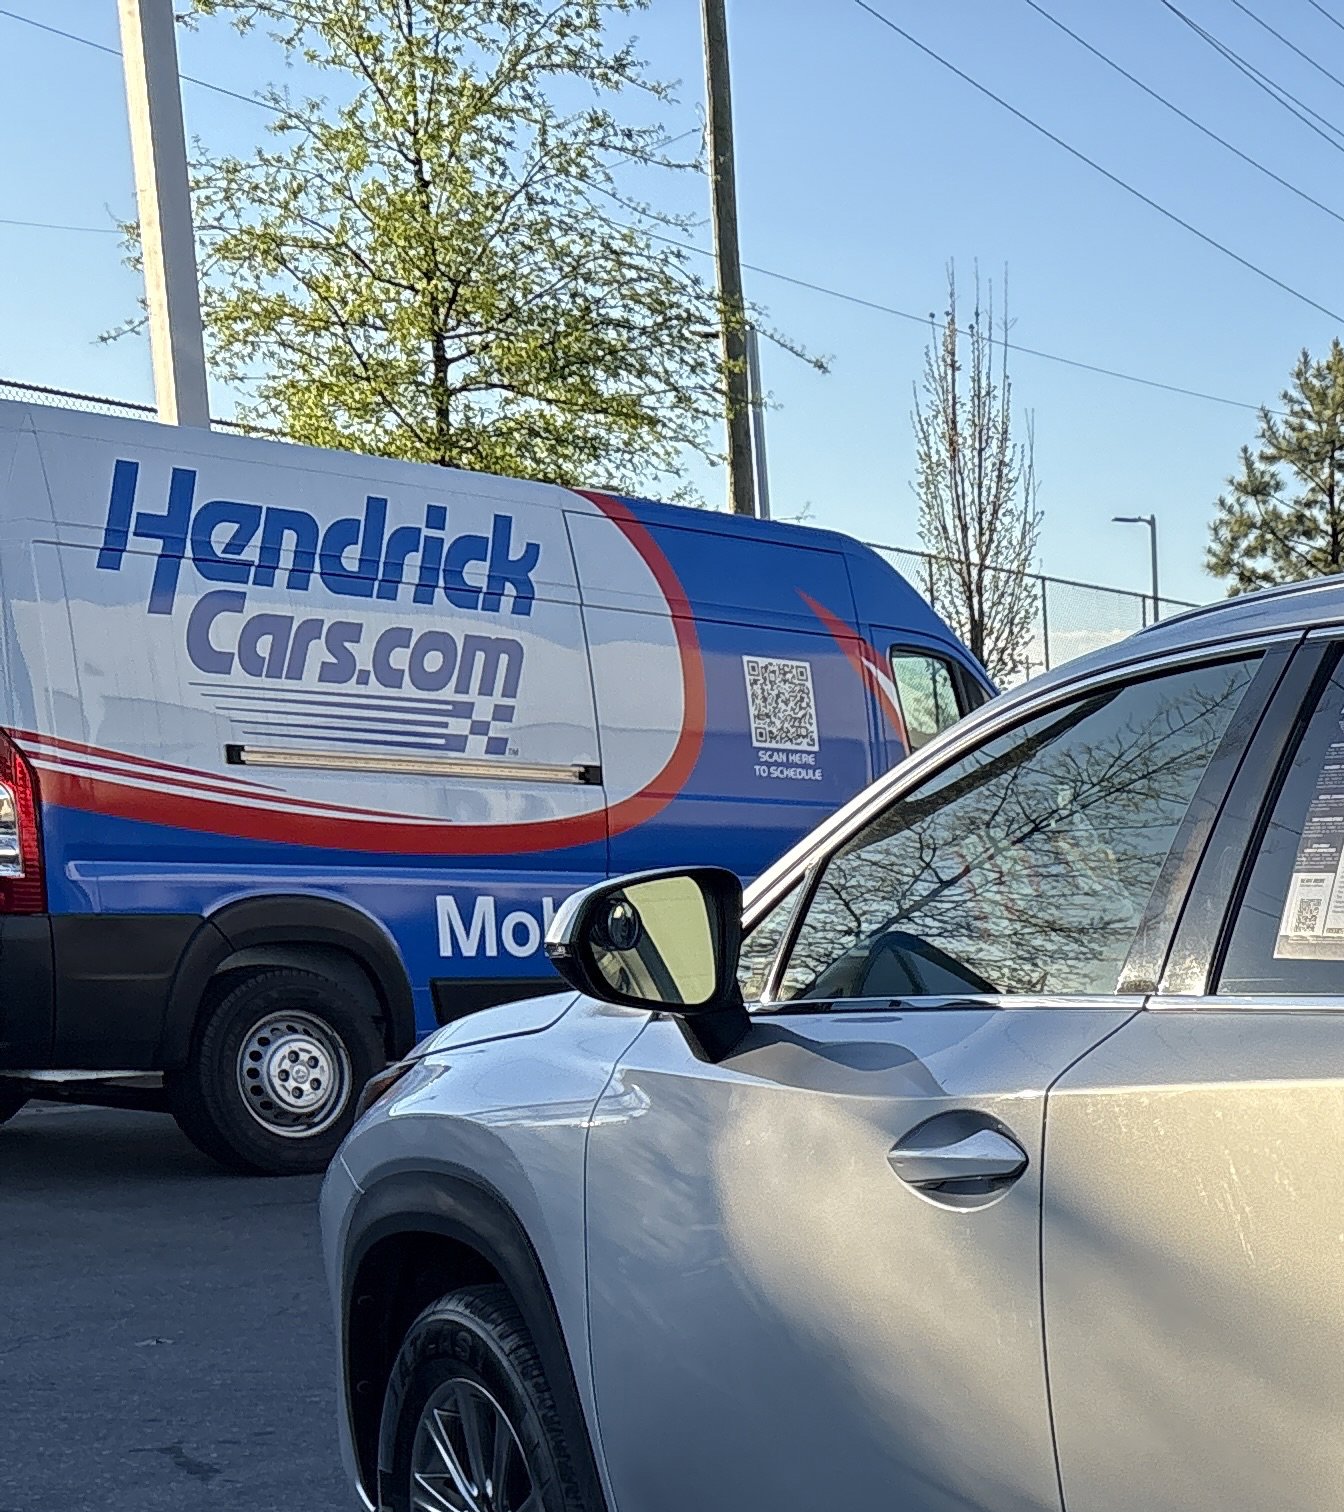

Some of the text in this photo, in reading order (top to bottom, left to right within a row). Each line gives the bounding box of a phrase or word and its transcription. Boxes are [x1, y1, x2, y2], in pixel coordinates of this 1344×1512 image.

[95, 459, 541, 616] Hendrick
[186, 590, 523, 698] Cars.com
[754, 765, 823, 780] TO SCHEDULE
[758, 750, 816, 765] SCAN HERE
